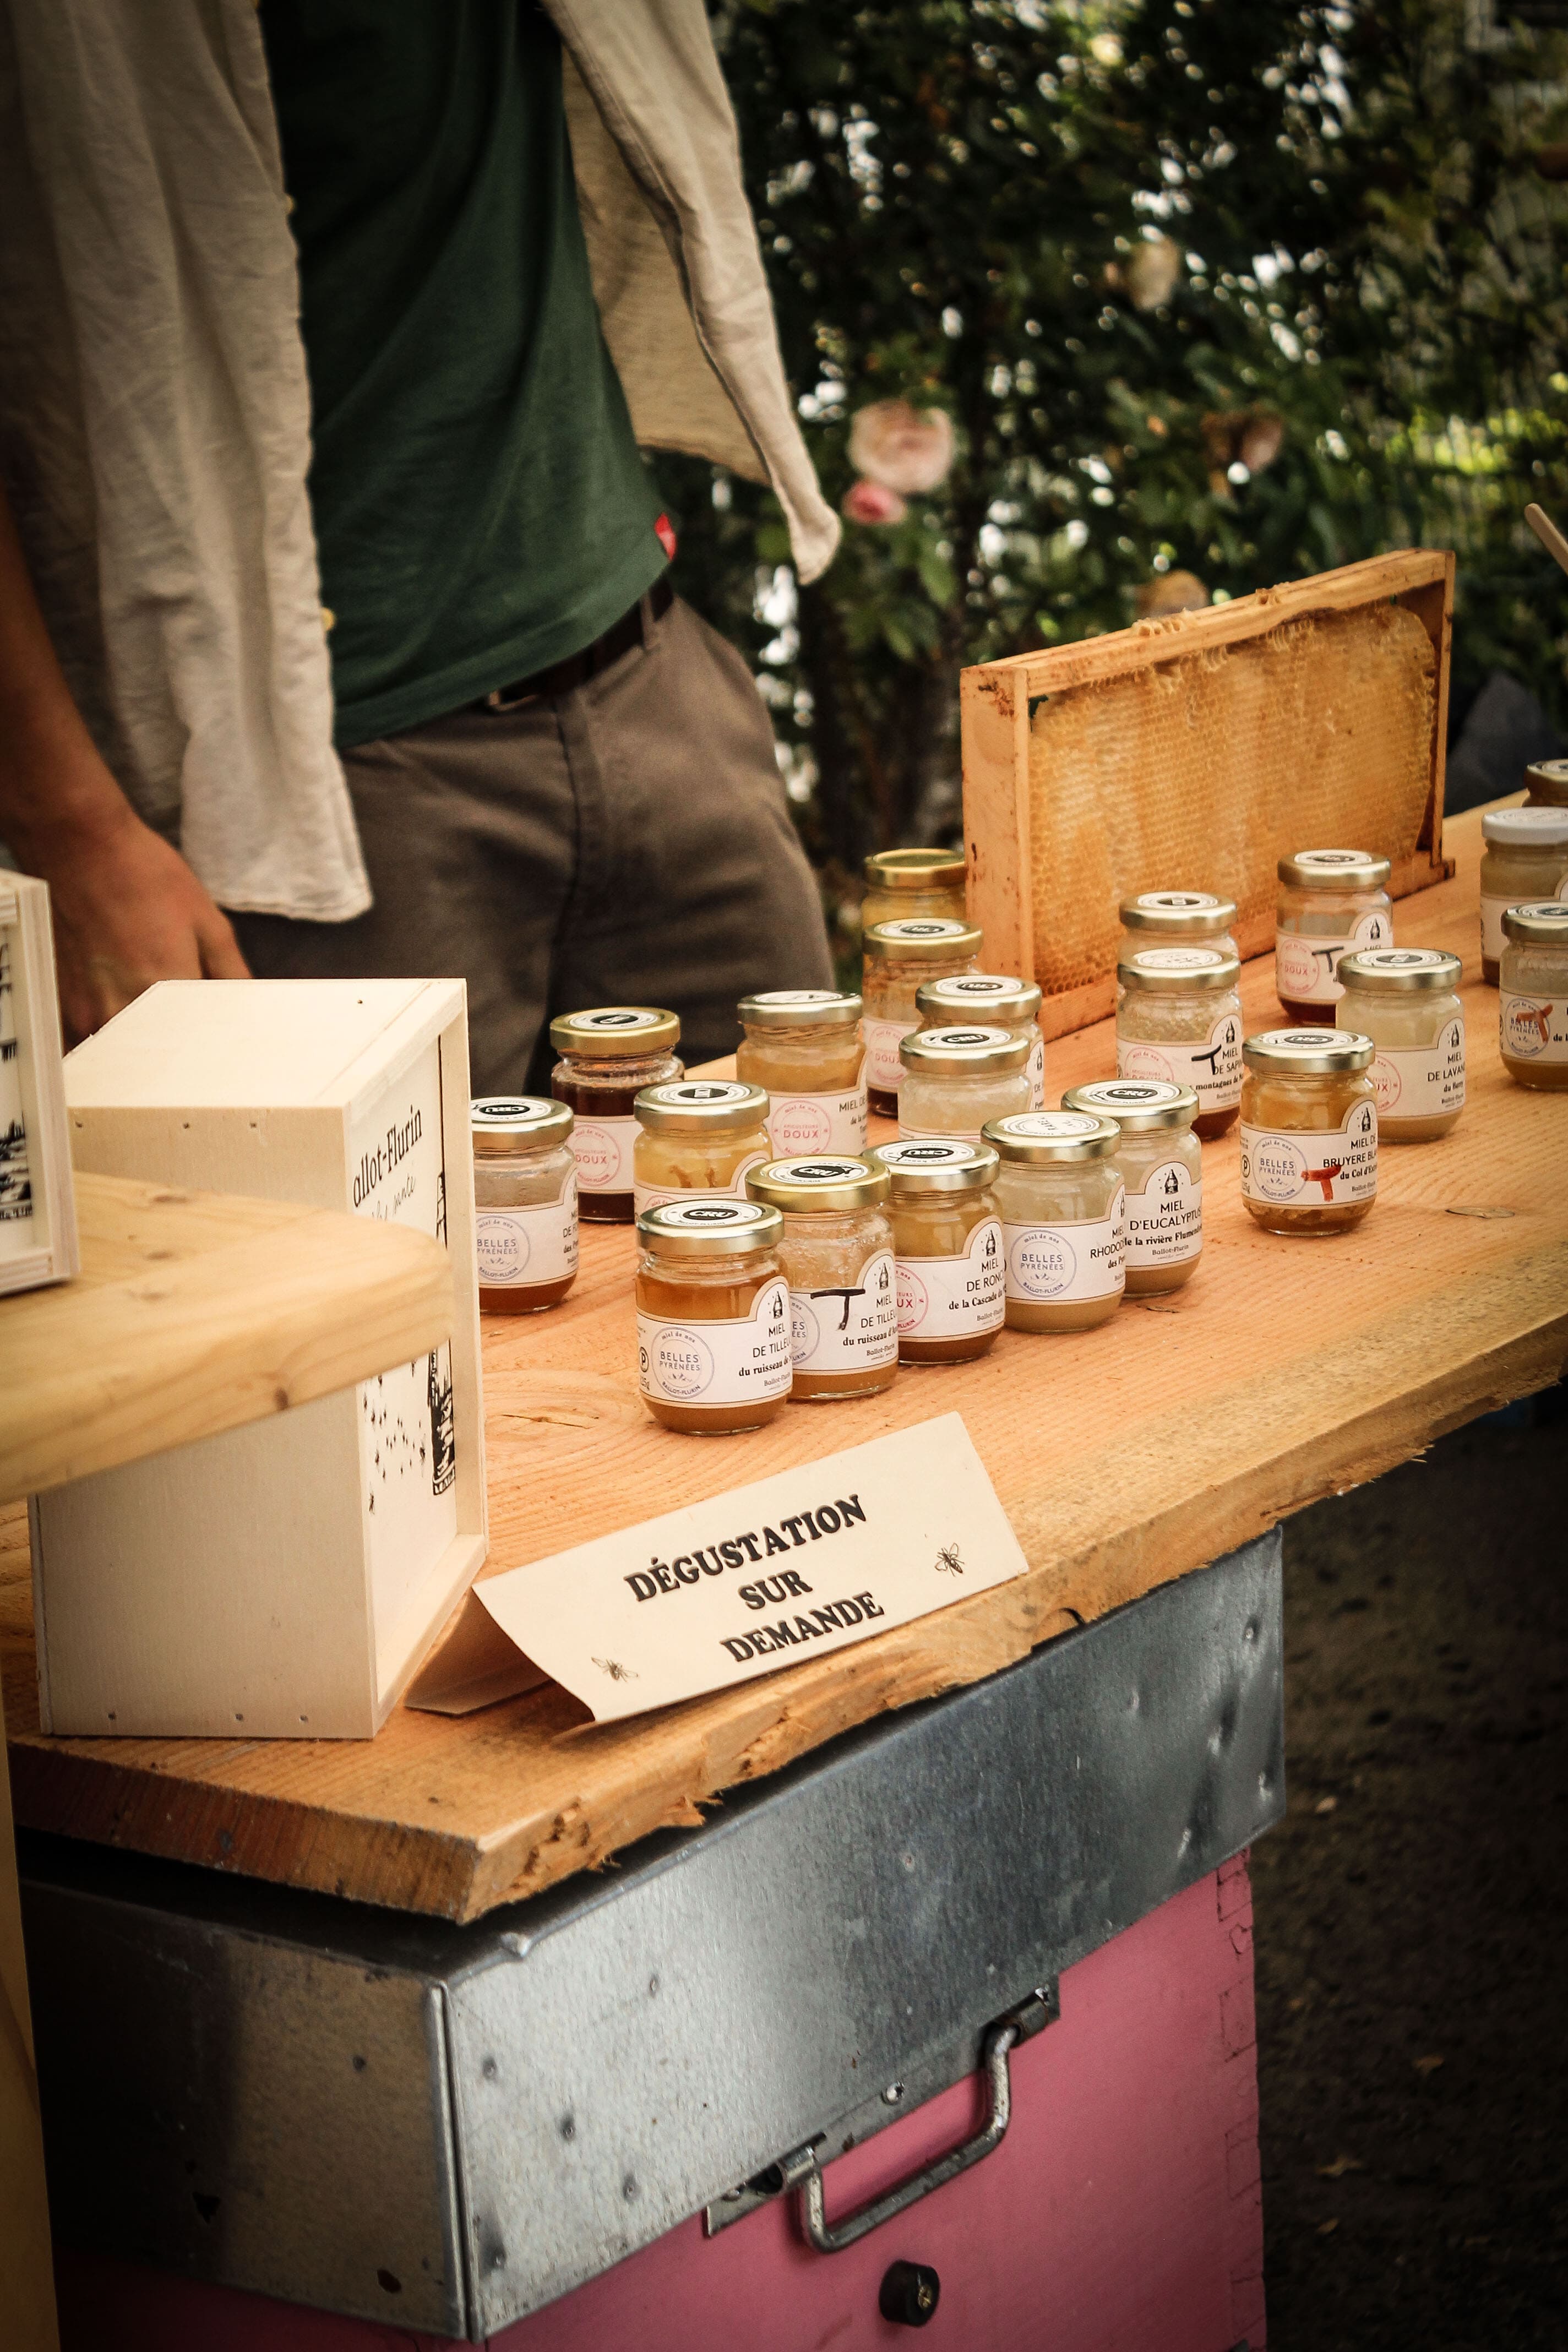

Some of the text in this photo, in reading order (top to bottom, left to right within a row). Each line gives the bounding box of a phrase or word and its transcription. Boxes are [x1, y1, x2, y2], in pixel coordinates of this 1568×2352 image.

[1222, 1048, 1238, 1059] MIEL
[1447, 1052, 1462, 1064] MIEL
[1428, 1071, 1440, 1082] DE
[1196, 1079, 1232, 1090] montagnes
[839, 1099, 857, 1112] MIEL
[783, 1130, 818, 1138] DOUX
[1351, 1137, 1369, 1150] MIEL
[353, 1104, 422, 1206] allot-Flurin
[576, 1155, 607, 1163] DOUX
[1323, 1153, 1365, 1168] BRUYERE
[1260, 1158, 1294, 1168] BELLES
[798, 1167, 840, 1177] CRU
[1340, 1172, 1349, 1180] du
[1352, 1168, 1363, 1177] Col
[1161, 1200, 1184, 1213] MIEL
[1130, 1206, 1201, 1231] D'EUCALYPTUS
[563, 1226, 571, 1238] DE
[477, 1239, 516, 1247] BELLES
[1025, 1234, 1037, 1243] miel
[1135, 1237, 1143, 1245] la
[1146, 1235, 1173, 1245] rivière
[1152, 1245, 1189, 1255] Ballot-Flurin
[1022, 1254, 1061, 1262] BELLES
[1108, 1260, 1117, 1268] des
[982, 1258, 998, 1272] MIEL
[1021, 1262, 1063, 1270] PYRÉNÉES
[967, 1280, 980, 1292] DE
[1023, 1282, 1063, 1293] BALLOT-FLURIN
[876, 1294, 892, 1308] MIEL
[897, 1298, 913, 1308] UX
[949, 1301, 959, 1310] de
[962, 1299, 969, 1308] la
[972, 1292, 997, 1306] Cascade
[810, 1288, 865, 1330] T
[861, 1317, 874, 1328] DE
[769, 1323, 785, 1337] MIEL
[843, 1337, 854, 1346] du
[858, 1333, 887, 1344] ruisseau
[660, 1351, 699, 1363] BELLES
[753, 1346, 766, 1358] DE
[641, 1352, 646, 1365] P
[660, 1360, 700, 1370] PYRÉNÉES
[739, 1368, 750, 1376] du
[753, 1361, 782, 1374] ruisseau
[662, 1381, 700, 1395] BALLOT-FLURIN
[624, 1494, 866, 1602] DÉGUSTATION
[738, 1569, 813, 1610] SUR
[719, 1591, 884, 1662] DEMANDE
